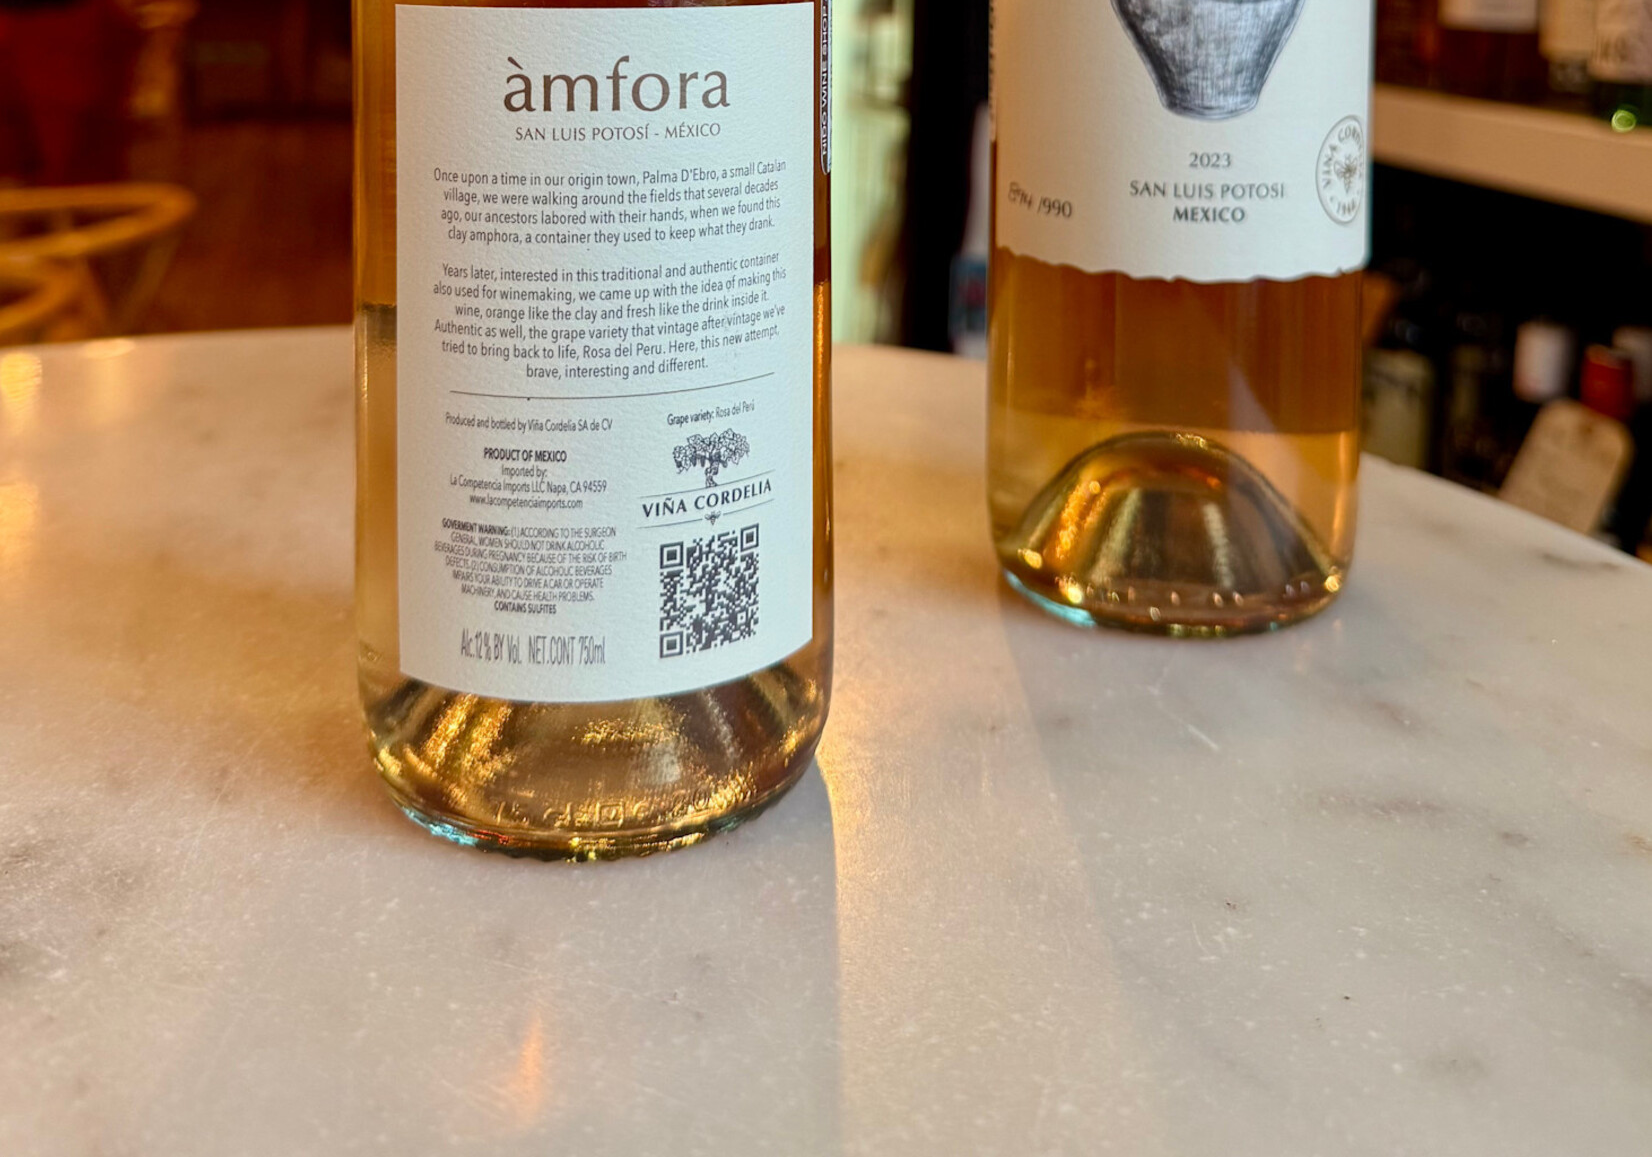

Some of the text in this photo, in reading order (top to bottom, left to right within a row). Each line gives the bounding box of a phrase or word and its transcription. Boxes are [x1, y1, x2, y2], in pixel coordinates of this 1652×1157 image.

[503, 55, 731, 112] àmfora
[515, 121, 721, 141] SAN LUIS POTOSÍ MÉXICO
[1188, 152, 1232, 168] 2023
[434, 159, 787, 190] Once upon a time in our origin town, Palma D'Ebro, a small Catalan
[443, 178, 778, 209] village, we were walking around the fields that several decades
[1129, 180, 1285, 200] SAN LUIS POTOSI
[440, 196, 781, 224] ago, our ancestors labored with their hands, when we found this
[1037, 195, 1073, 218] /990
[1173, 205, 1246, 224] MEXICO
[442, 252, 779, 282] Years later, interested in this traditional and authentic container
[433, 267, 787, 304] also used for winemaking, we came up with the idea of making this
[455, 289, 769, 323] wine, orange like the clay and fresh like the drink inside it.
[442, 324, 779, 361] tried to bring back to life, Rosa del Peru. Here, this new attempt,
[526, 357, 708, 380] brave, interesting and different.
[445, 412, 613, 434] Produced and bottled by Viña Cordelia SA de CV
[667, 413, 689, 428] Grape
[690, 409, 715, 424] variety:
[715, 406, 731, 418] Rosa
[731, 402, 741, 415] del
[483, 447, 567, 463] PRODUCT OF MEXICO
[450, 474, 608, 496] La Competencia Imports LLC Napa, CA 94559
[501, 464, 548, 482] Imported by:
[642, 478, 772, 518] VIÑA CORDELIA
[494, 600, 557, 614] CONTAINS SULFITES
[493, 633, 505, 661] BY
[506, 634, 522, 664] Vol.
[528, 635, 576, 665] NET.CONT
[578, 635, 606, 665] 750ml
